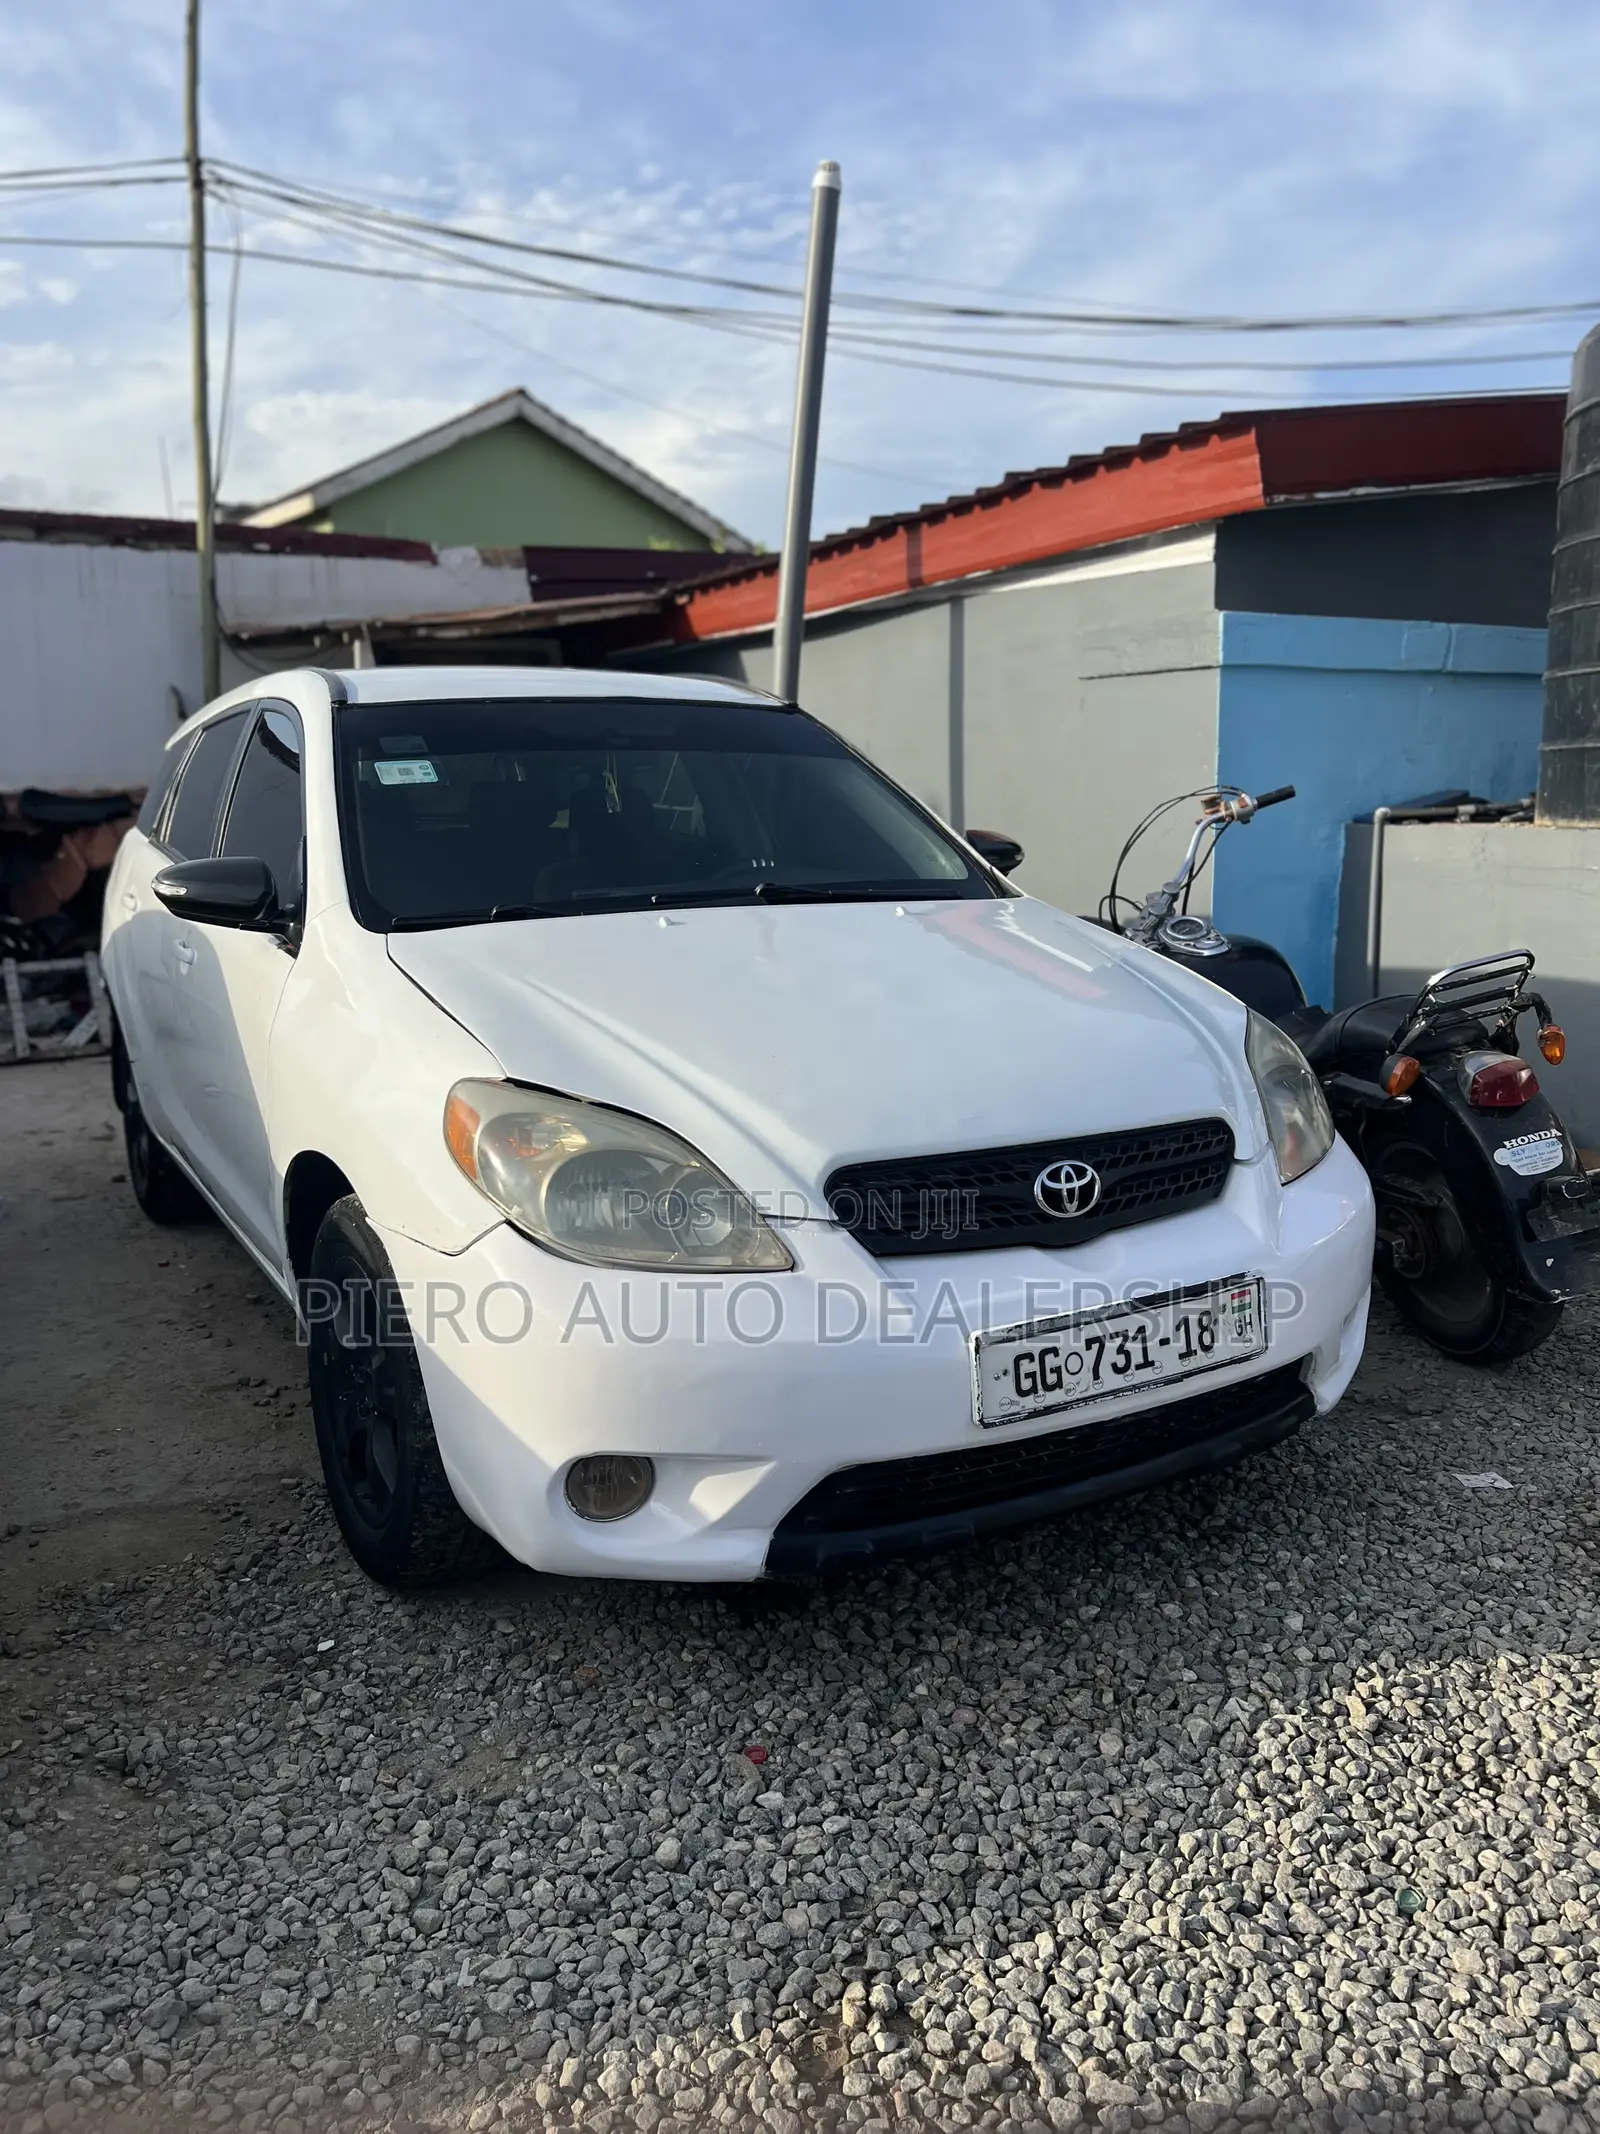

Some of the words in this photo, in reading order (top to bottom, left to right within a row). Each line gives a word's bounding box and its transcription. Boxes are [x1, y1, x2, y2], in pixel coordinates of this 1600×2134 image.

[1503, 1128, 1562, 1149] HONDA
[1235, 1313, 1254, 1337] GH
[1013, 1346, 1064, 1397] GG
[1085, 1310, 1216, 1381] 731-18
